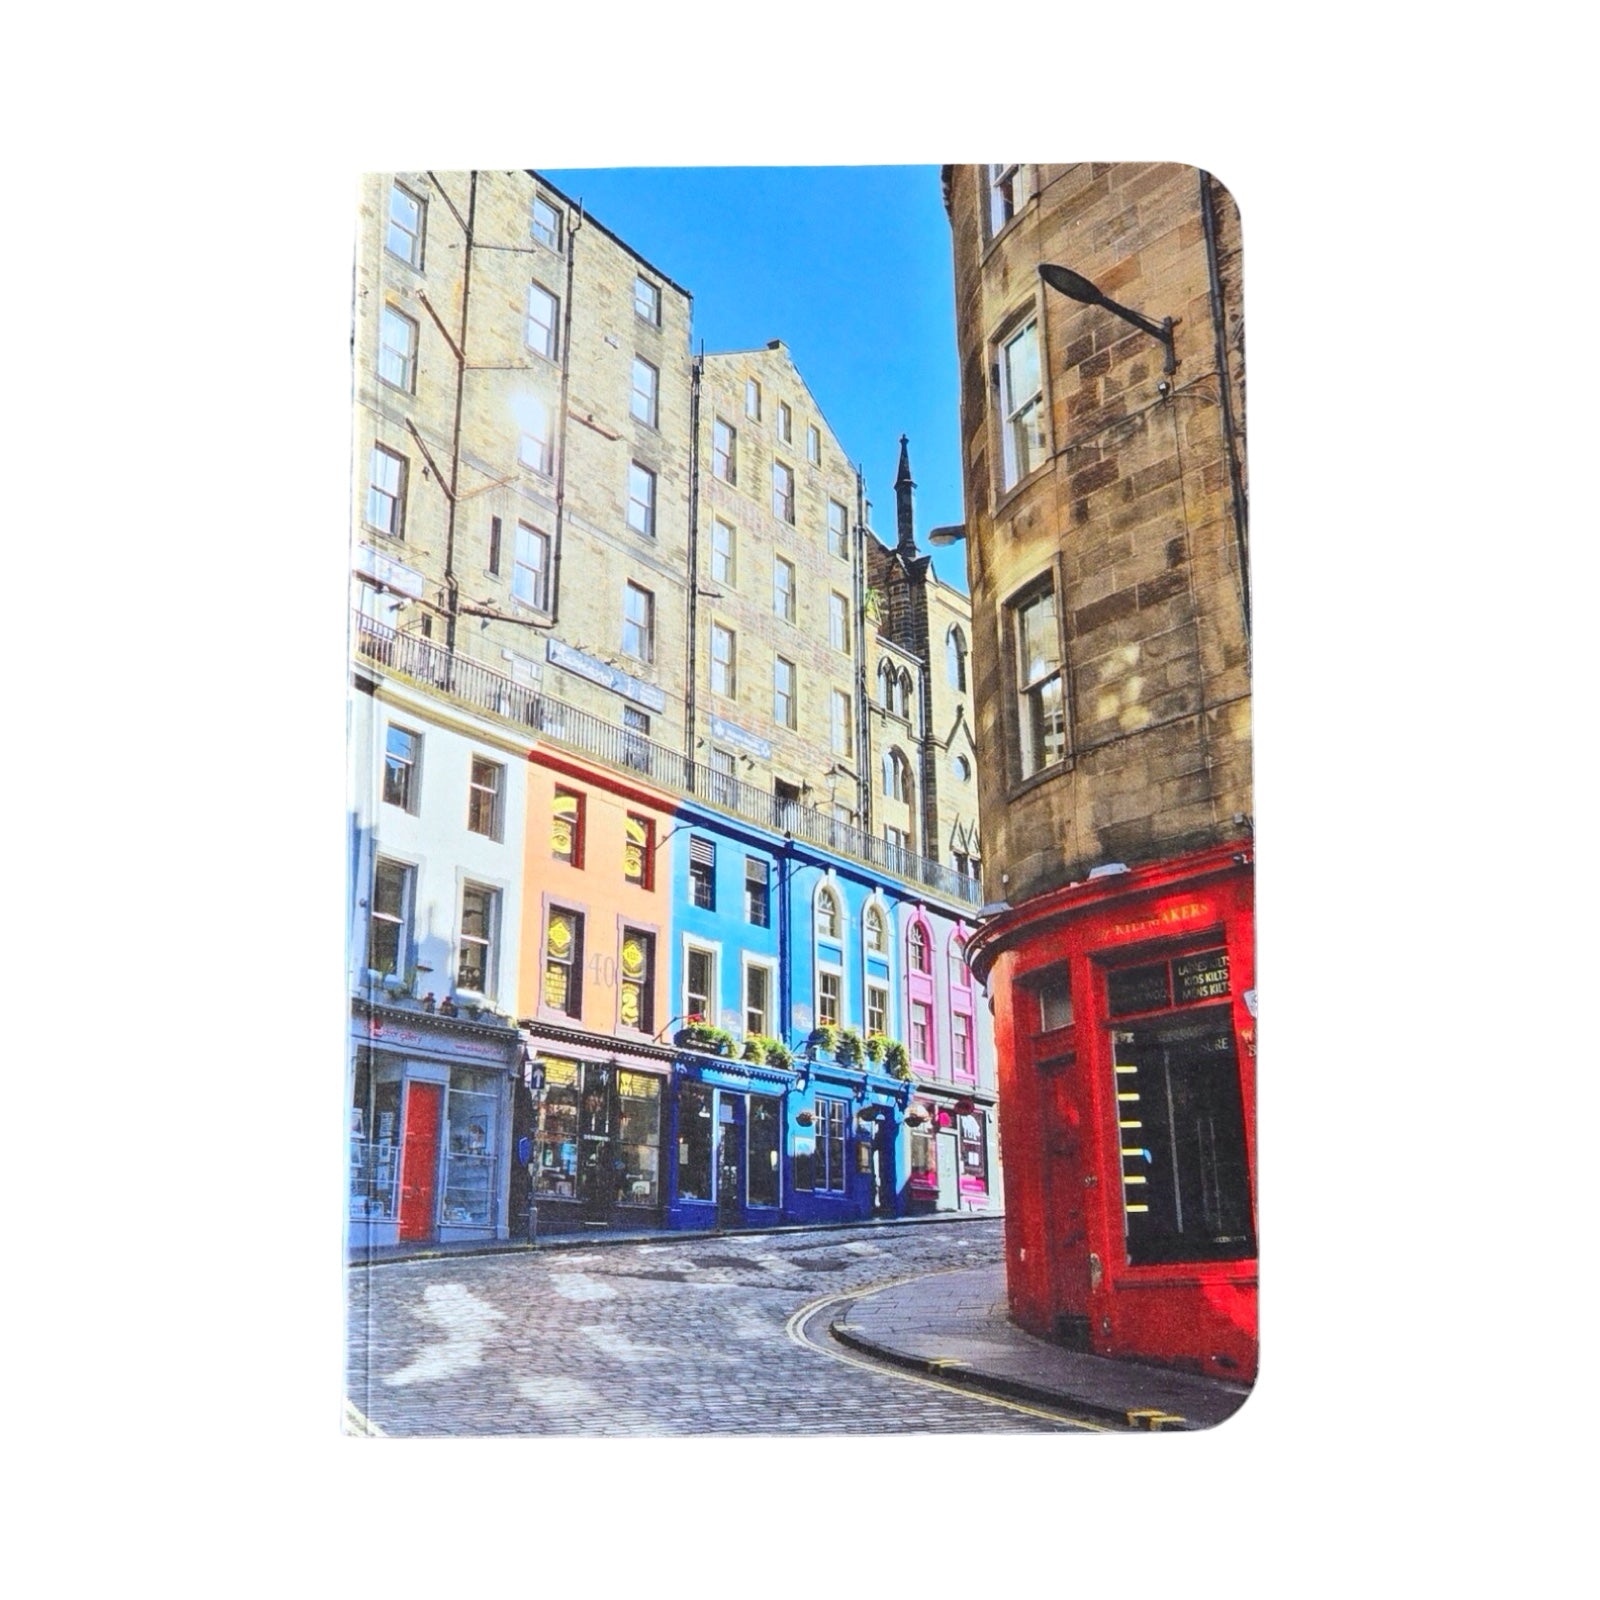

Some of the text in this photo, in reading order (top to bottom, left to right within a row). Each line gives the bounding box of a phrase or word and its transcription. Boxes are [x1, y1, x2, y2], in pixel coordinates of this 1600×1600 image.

[1184, 969, 1228, 987] KIDS KILTS
[1209, 981, 1232, 996] KILTS
